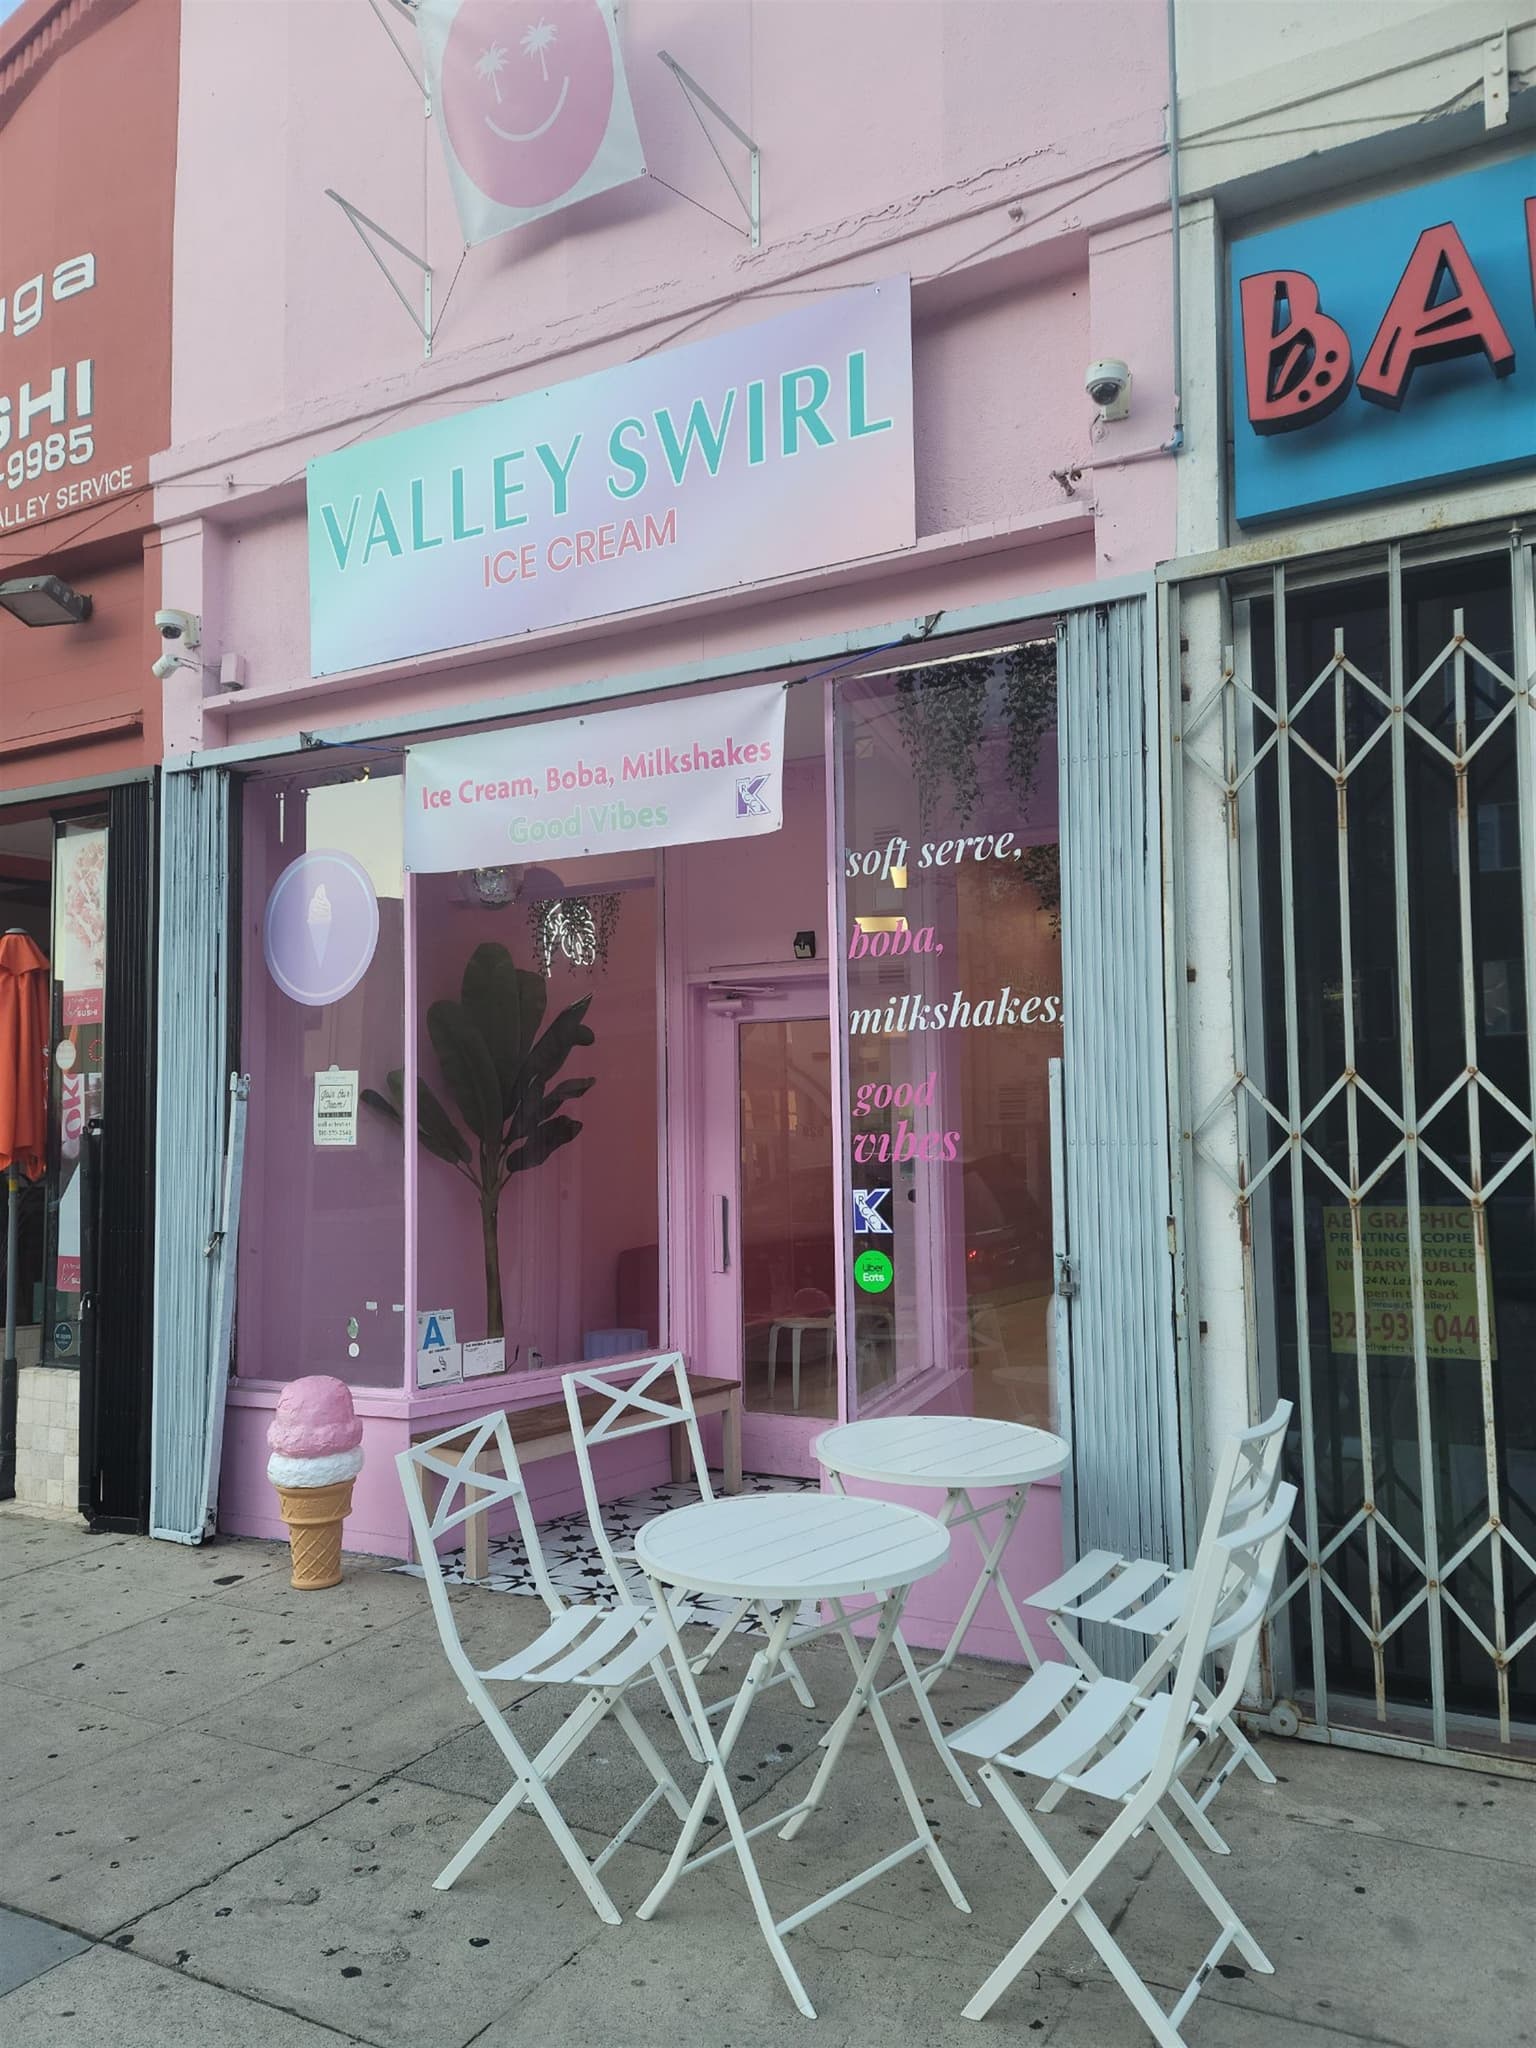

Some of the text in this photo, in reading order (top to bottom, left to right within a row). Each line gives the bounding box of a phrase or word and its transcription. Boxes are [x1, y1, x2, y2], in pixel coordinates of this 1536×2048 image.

[1240, 197, 1536, 434] BA
[0, 359, 93, 450] HI
[319, 350, 893, 572] VALLEY SWIRL
[56, 465, 133, 510] SERVICE
[483, 508, 677, 588] ICE CREAM
[422, 737, 772, 811] Ice Cream, Boba, Milkshakes
[508, 801, 668, 844] Good Vibes
[846, 832, 1022, 881] soft serve,
[848, 919, 944, 960] boba,
[852, 1072, 937, 1117] good
[853, 1120, 960, 1163] vibes
[1330, 1232, 1473, 1244] PRNTING COPIE
[1337, 1247, 1401, 1257] MILING
[862, 1263, 884, 1272] Uber
[862, 1272, 886, 1283] Eats
[1366, 1290, 1389, 1300] pen
[422, 1316, 446, 1350] A
